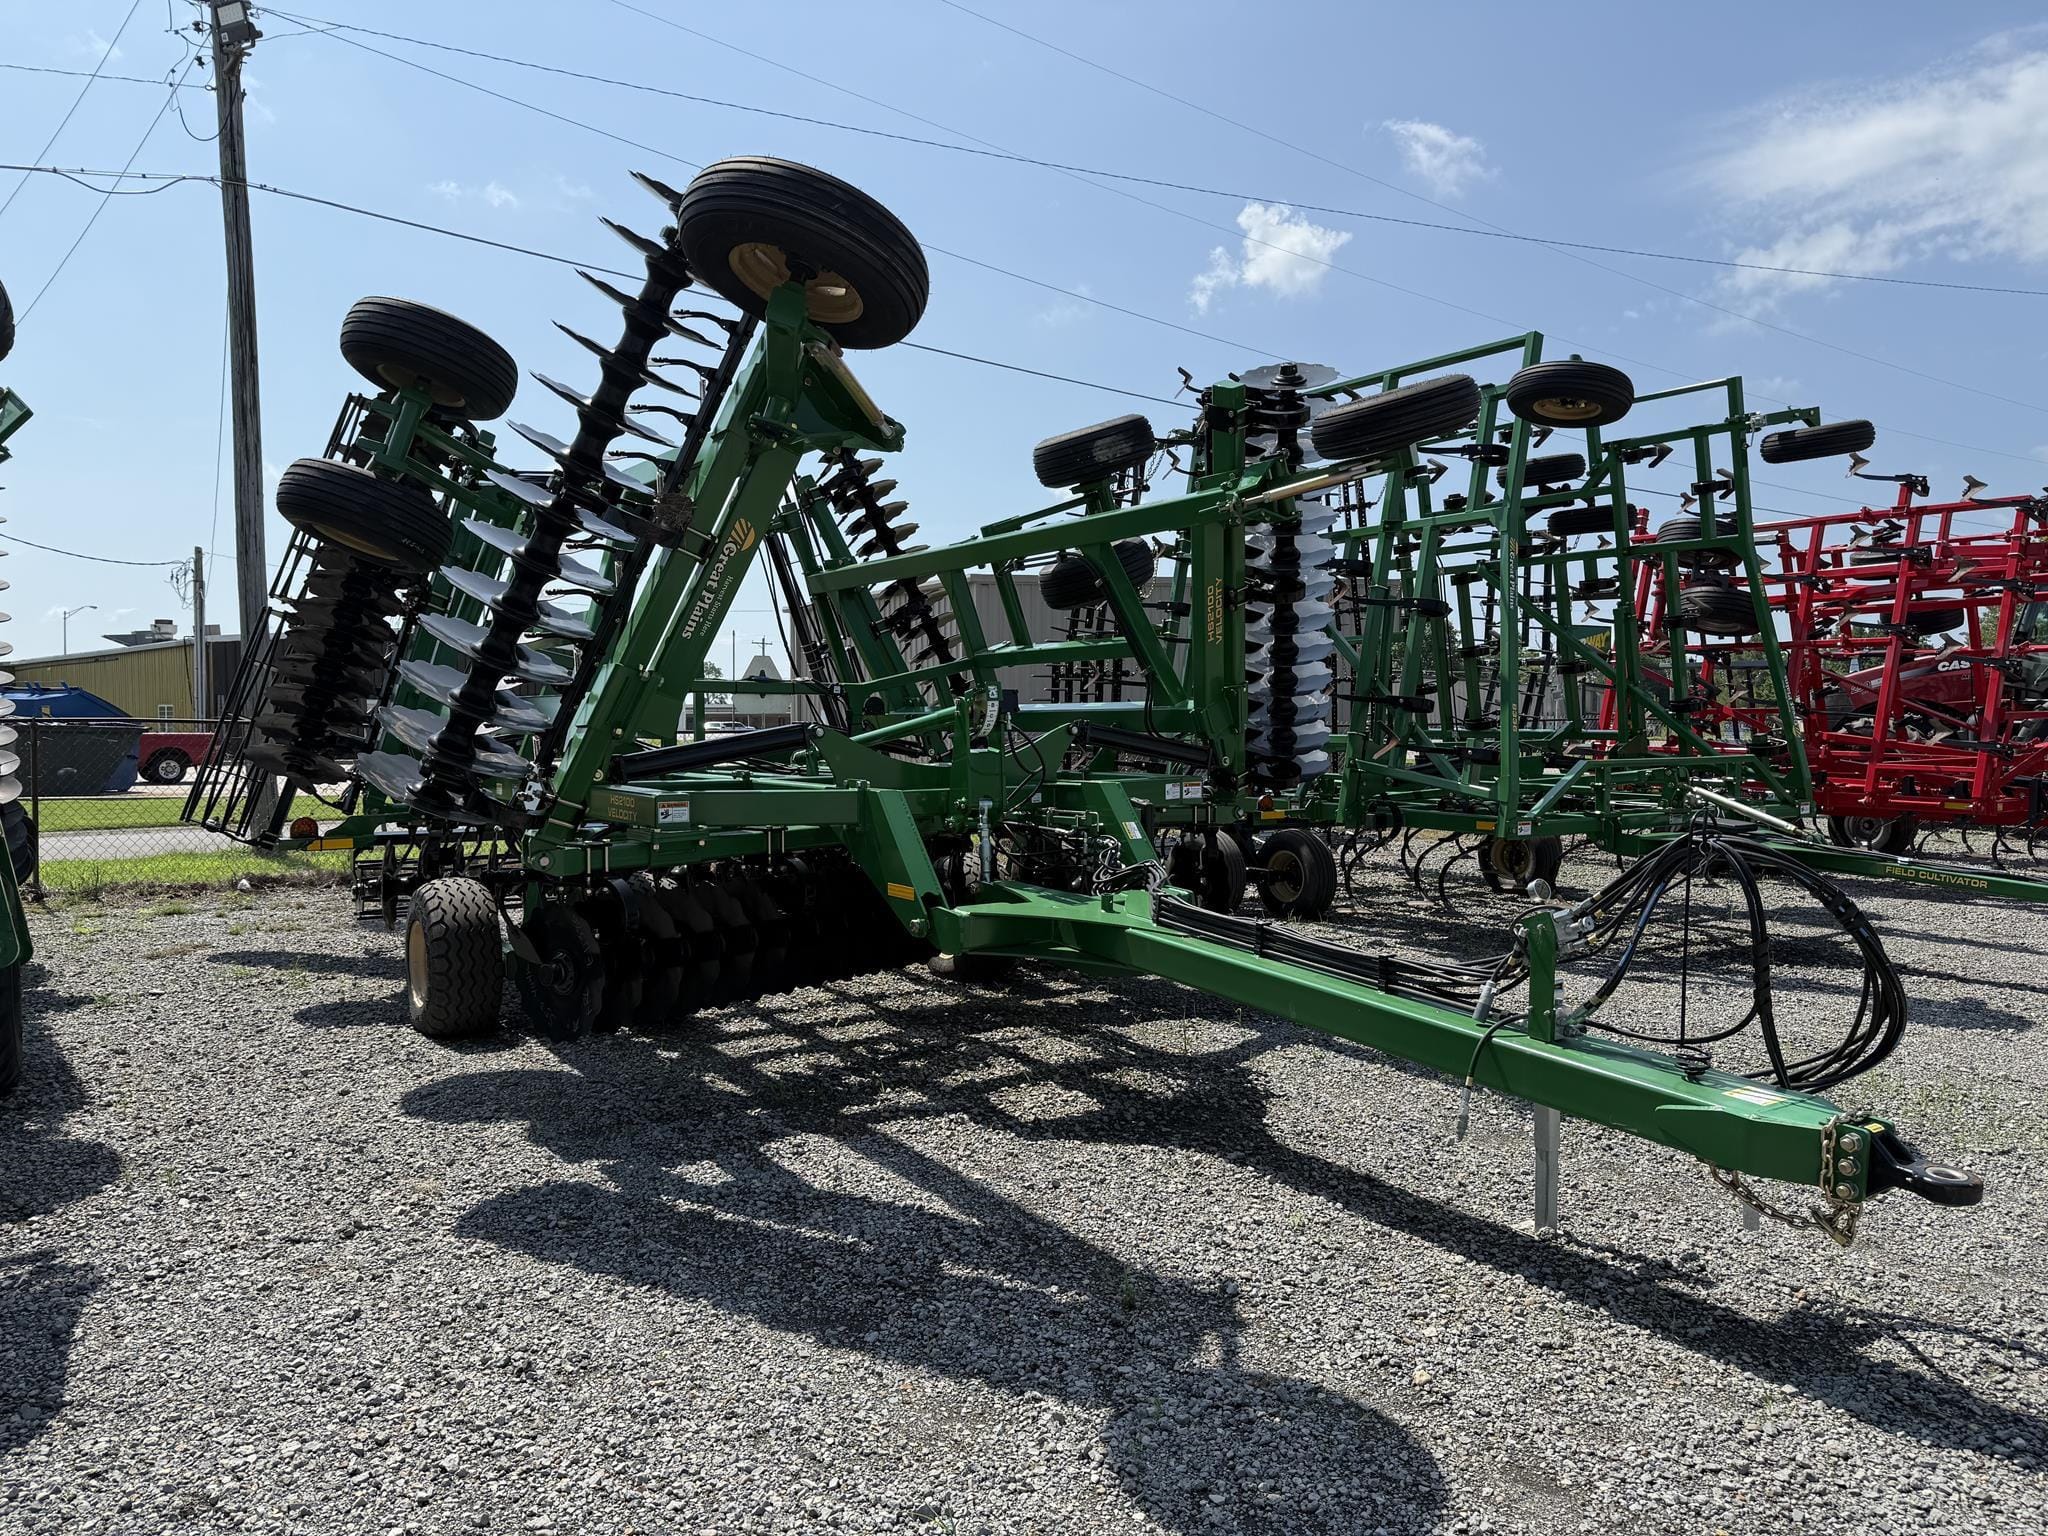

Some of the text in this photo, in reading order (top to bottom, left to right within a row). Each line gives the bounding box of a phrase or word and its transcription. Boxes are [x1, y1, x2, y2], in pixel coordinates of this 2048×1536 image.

[682, 542, 737, 640] Great Plains
[700, 575, 734, 637] Harvest Starts Here
[1215, 577, 1223, 645] VELOCITY
[1937, 659, 1972, 672] CAS
[607, 806, 638, 822] VELOCITY
[1885, 866, 1989, 889] FIELD CULTIVATOR
